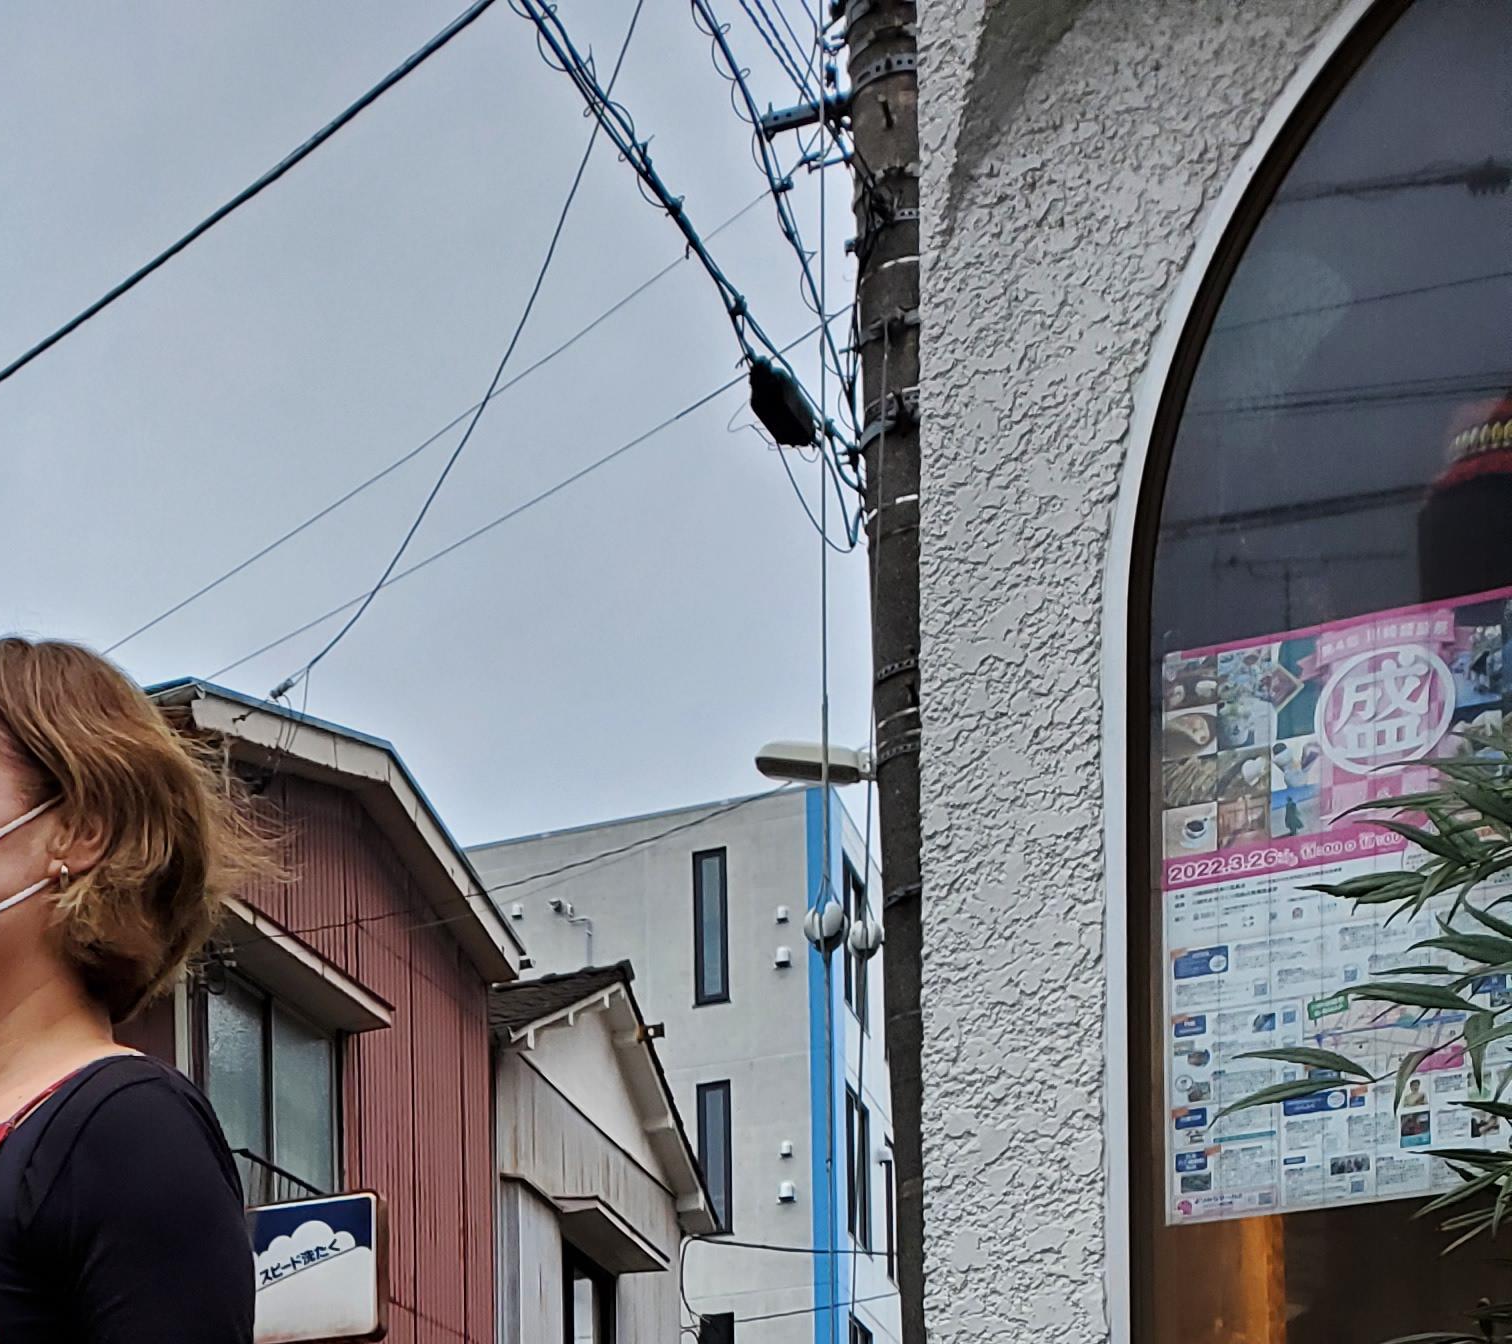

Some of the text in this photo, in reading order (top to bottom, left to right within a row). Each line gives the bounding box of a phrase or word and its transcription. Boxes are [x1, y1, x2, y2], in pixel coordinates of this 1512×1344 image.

[1167, 848, 1278, 883] 2022.3.26
[1301, 841, 1343, 860] 11:00
[259, 1238, 341, 1285] スピード洗たく
